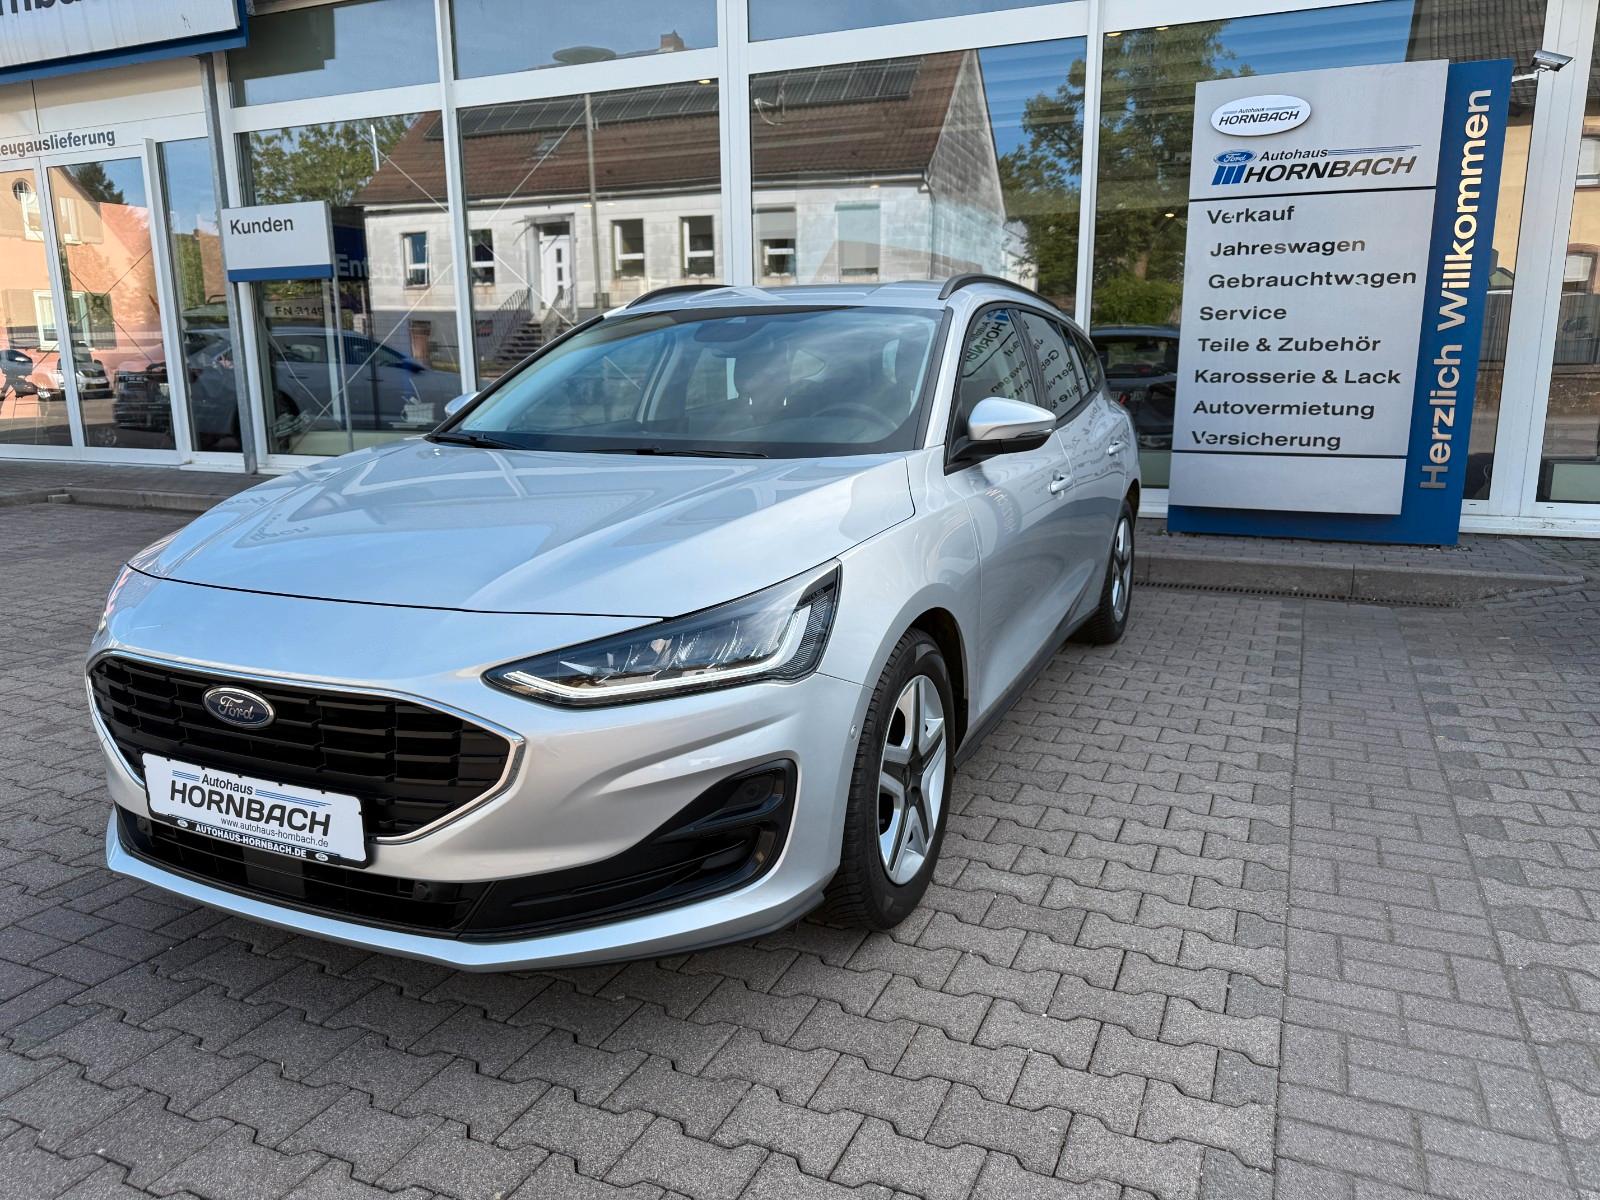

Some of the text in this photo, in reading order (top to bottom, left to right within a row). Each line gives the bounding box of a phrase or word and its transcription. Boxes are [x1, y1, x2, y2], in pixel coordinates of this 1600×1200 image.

[1219, 110, 1300, 126] HORNBACH
[1238, 107, 1265, 115] Autohaus
[0, 130, 116, 158] eugauslieferung
[1223, 152, 1247, 163] Ford
[1259, 149, 1328, 162] Autohaus
[1243, 156, 1418, 184] HORNBACH
[1207, 206, 1295, 224] Verkauf
[230, 217, 294, 236] Kunden
[1210, 240, 1366, 257] Jahreswagen
[1208, 271, 1417, 290] Gebrauchtwagen
[1419, 88, 1492, 490] Herzlich Willkommen
[1200, 305, 1288, 322] Service
[1198, 335, 1381, 353] Teile & Zubehör
[1194, 369, 1402, 385] Karosserie & Lack
[1193, 400, 1375, 420] Autovermietung
[1191, 430, 1341, 451] Versicherung
[218, 695, 255, 720] Ford
[201, 774, 253, 796] Autohaus
[170, 780, 331, 837] HORNBACH
[195, 823, 307, 858] AUTOHAUS-HORNBACH.DE
